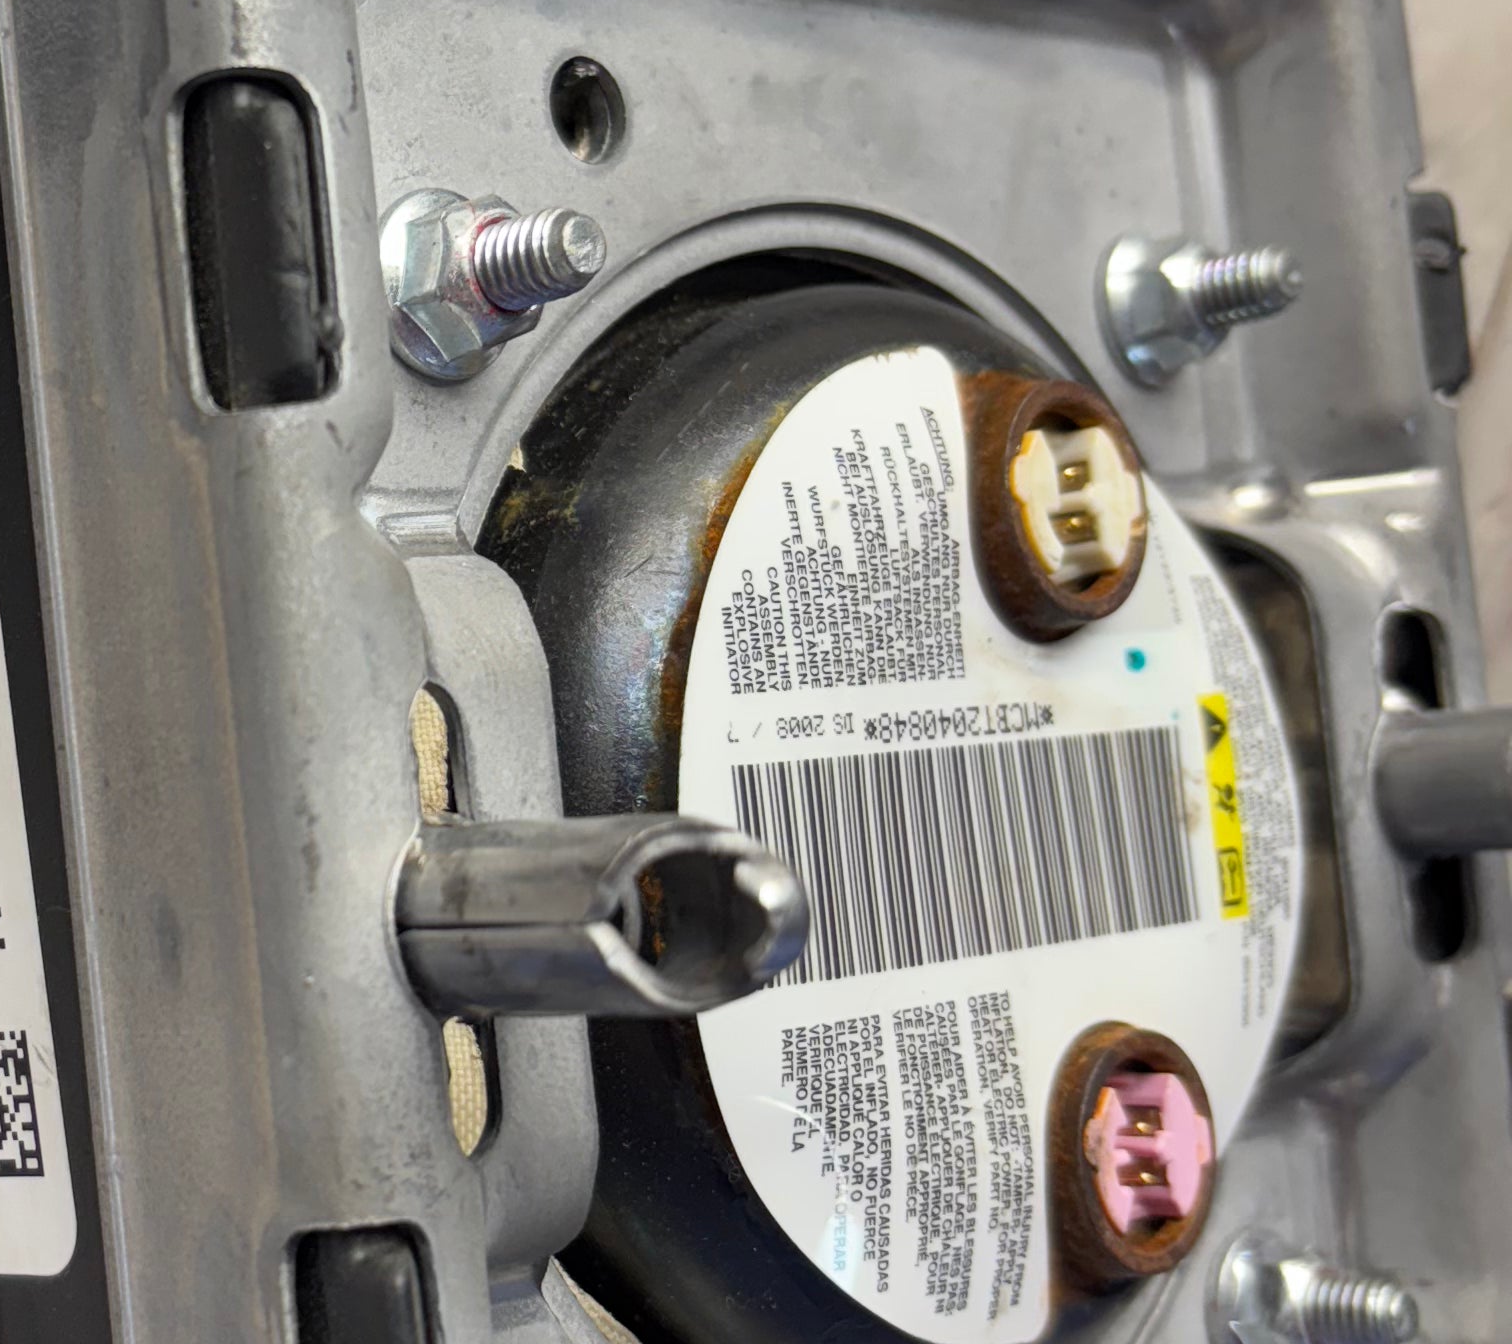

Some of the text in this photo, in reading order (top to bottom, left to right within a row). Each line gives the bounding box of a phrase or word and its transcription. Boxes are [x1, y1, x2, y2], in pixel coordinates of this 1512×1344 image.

[920, 407, 954, 492] ACHTUNG:
[782, 482, 821, 689] INERTE GEGENSTÄNDE
[808, 486, 844, 687] WURFSTÜCK WERDEN.
[832, 448, 876, 685] NICHT MONTIERTE AIRBAG-
[845, 452, 886, 684] BEI AUSLÖSUNG KANN DIE
[850, 429, 896, 683] KRAFTFAHRZEUGE ERLAUBT.
[880, 447, 916, 682] RÜCKHALTESYSTEMEN MIT
[896, 423, 935, 680] ERLAUBT. VERWENDUNG NUR
[920, 463, 945, 680] GESCHULTES PERSONAL
[937, 492, 955, 679] UMGANG NUR DURCH
[742, 570, 767, 692] CONTAINS AN
[767, 567, 792, 691] CAUTION THIS
[781, 538, 808, 690] VERSCHROTTEN.
[806, 546, 826, 634] ACHTUNG
[820, 651, 833, 688] NUR
[831, 546, 855, 686] GEFÄHRLICHEN
[847, 574, 866, 686] EINHEIT ZUM
[890, 549, 903, 642] LUFTSACK
[911, 548, 925, 680] ALS INSASSEN-
[722, 607, 741, 694] INITIATOR
[732, 592, 754, 694] EXPLOSIVE
[758, 595, 779, 691] ASSEMBLY
[774, 713, 824, 739] 2008
[848, 1018, 857, 1034] NI
[892, 1010, 909, 1085] VERIFIER
[902, 1009, 913, 1029] LE
[913, 1007, 923, 1029] DE
[946, 1000, 960, 1046] POUR
[978, 994, 992, 1036] HEAT
[984, 1040, 996, 1063] OR
[781, 1029, 793, 1087] PARTE.
[796, 1027, 812, 1100] NÚMERO
[809, 1024, 822, 1114] VERIFIQUE
[835, 1021, 850, 1146] ELECTRICIDAD.
[916, 1034, 937, 1127] PUISSANCE
[952, 1051, 968, 1099] AIDER
[902, 1090, 913, 1110] LE
[904, 1115, 914, 1138] NO
[946, 1084, 959, 1115] PAR
[952, 1120, 962, 1140] LE
[968, 996, 1000, 1233] OPERATION, VERIFY PART NO.
[989, 1069, 1008, 1147] ELECTRIC
[1003, 1086, 1014, 1109] DO
[1009, 1115, 1020, 1151] NOT:
[791, 1132, 806, 1153] LA
[851, 1128, 864, 1185] CALOR
[859, 1017, 878, 1261] POR EL INFLADO, NO FUERCE
[870, 1015, 891, 1293] PARA EVITAR HERIDAS CAUSADAS
[906, 1144, 916, 1167] DE
[936, 1095, 953, 1187] APPLIQUER
[963, 1121, 976, 1178] ÉVITER
[1000, 991, 1034, 1306] TO HELP AVOID PERSONAL INJURY FROM
[851, 1190, 863, 1202] O
[943, 1193, 953, 1214] DE
[952, 1145, 965, 1239] GONFLAGE,
[967, 1184, 976, 1213] LES
[834, 1203, 847, 1271] OPERAR
[926, 1252, 939, 1296] POUR
[937, 1219, 952, 1295] CHALEUR
[950, 1247, 962, 1278] NES
[957, 1218, 975, 1311] BLESSURES
[998, 1222, 1009, 1253] FOR
[1003, 1239, 1017, 1284] APPLY
[935, 1299, 944, 1313] NI
[987, 1259, 1004, 1321] PROPER
